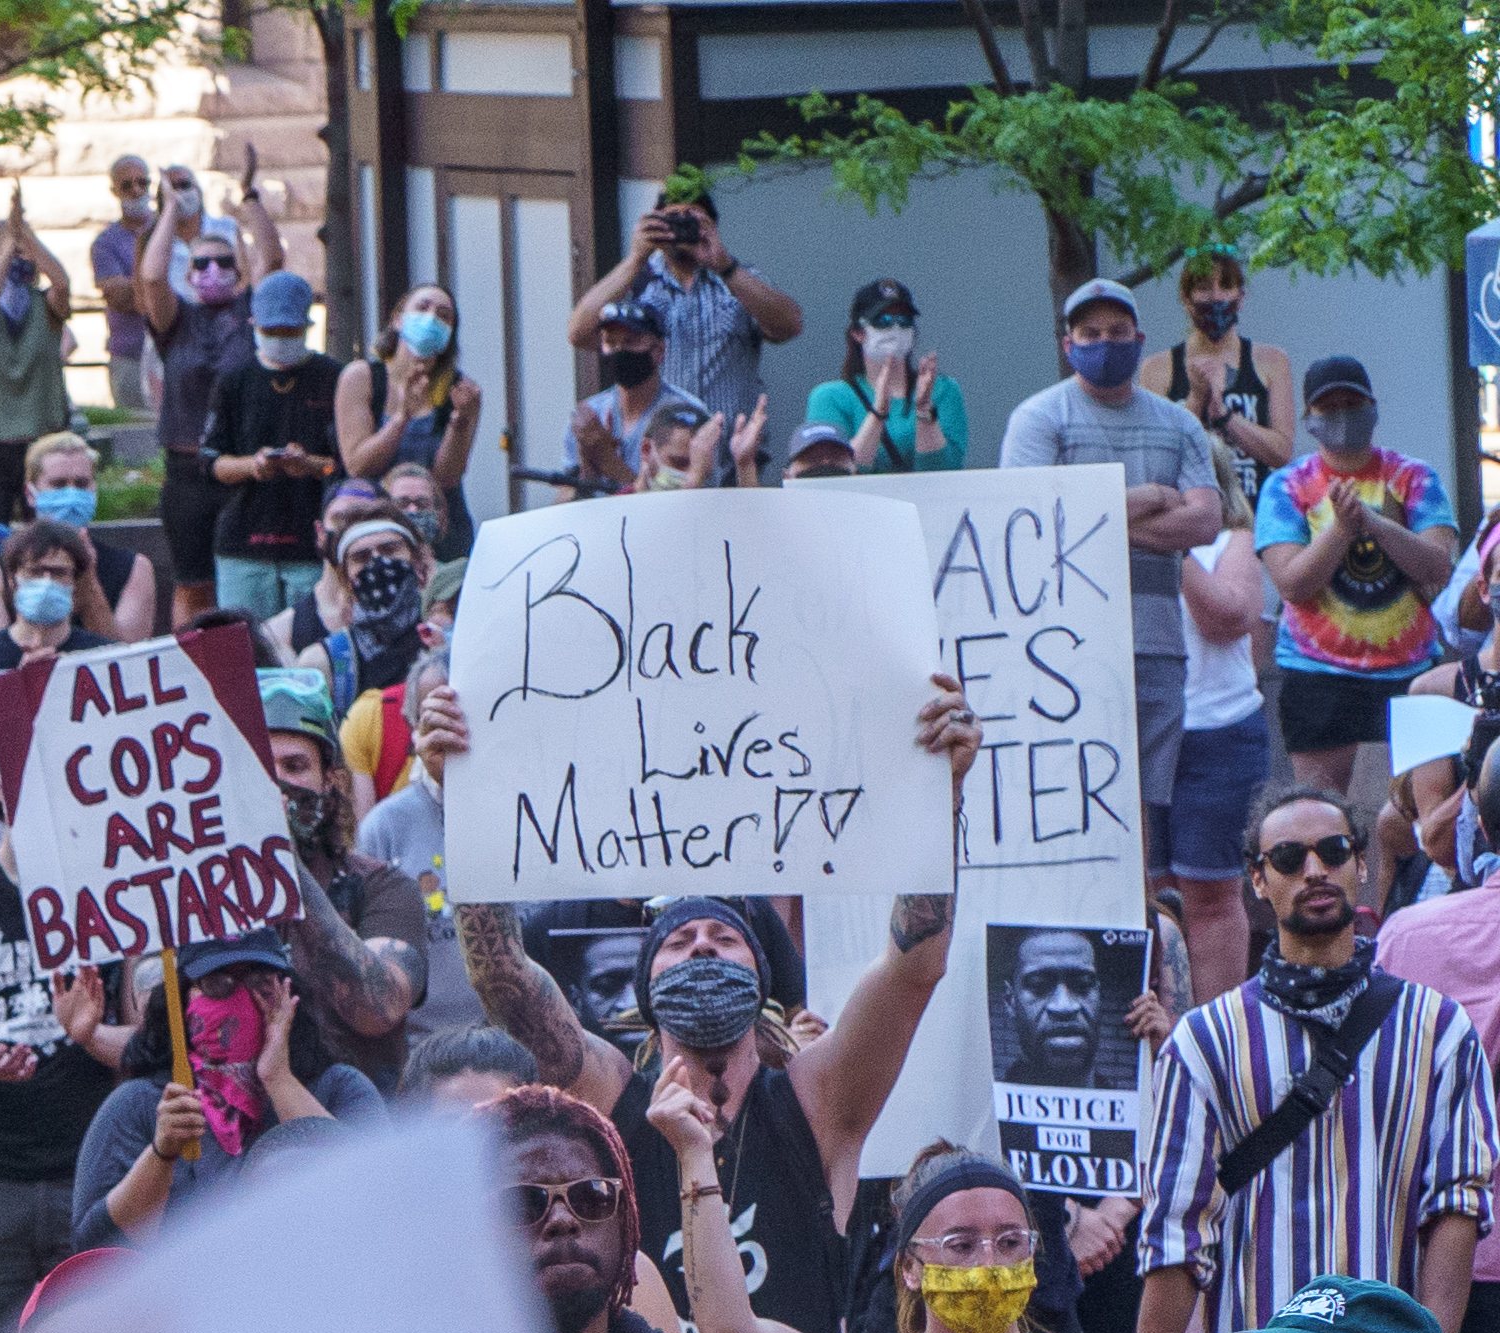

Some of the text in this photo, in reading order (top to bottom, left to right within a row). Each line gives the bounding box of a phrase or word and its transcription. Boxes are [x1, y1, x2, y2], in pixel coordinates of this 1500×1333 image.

[933, 497, 1111, 619] ACK
[482, 516, 762, 722] Black
[71, 655, 188, 723] ALL
[64, 711, 222, 806] COPS
[636, 697, 812, 785] Lives
[103, 794, 226, 869] ARE
[513, 762, 866, 883] Matter!!
[982, 738, 1131, 846] TER
[27, 835, 301, 970] BASTARDS
[1005, 1091, 1126, 1124] JUSTICE
[1045, 1129, 1084, 1149] FOR
[1008, 1149, 1135, 1191] FLOYD
